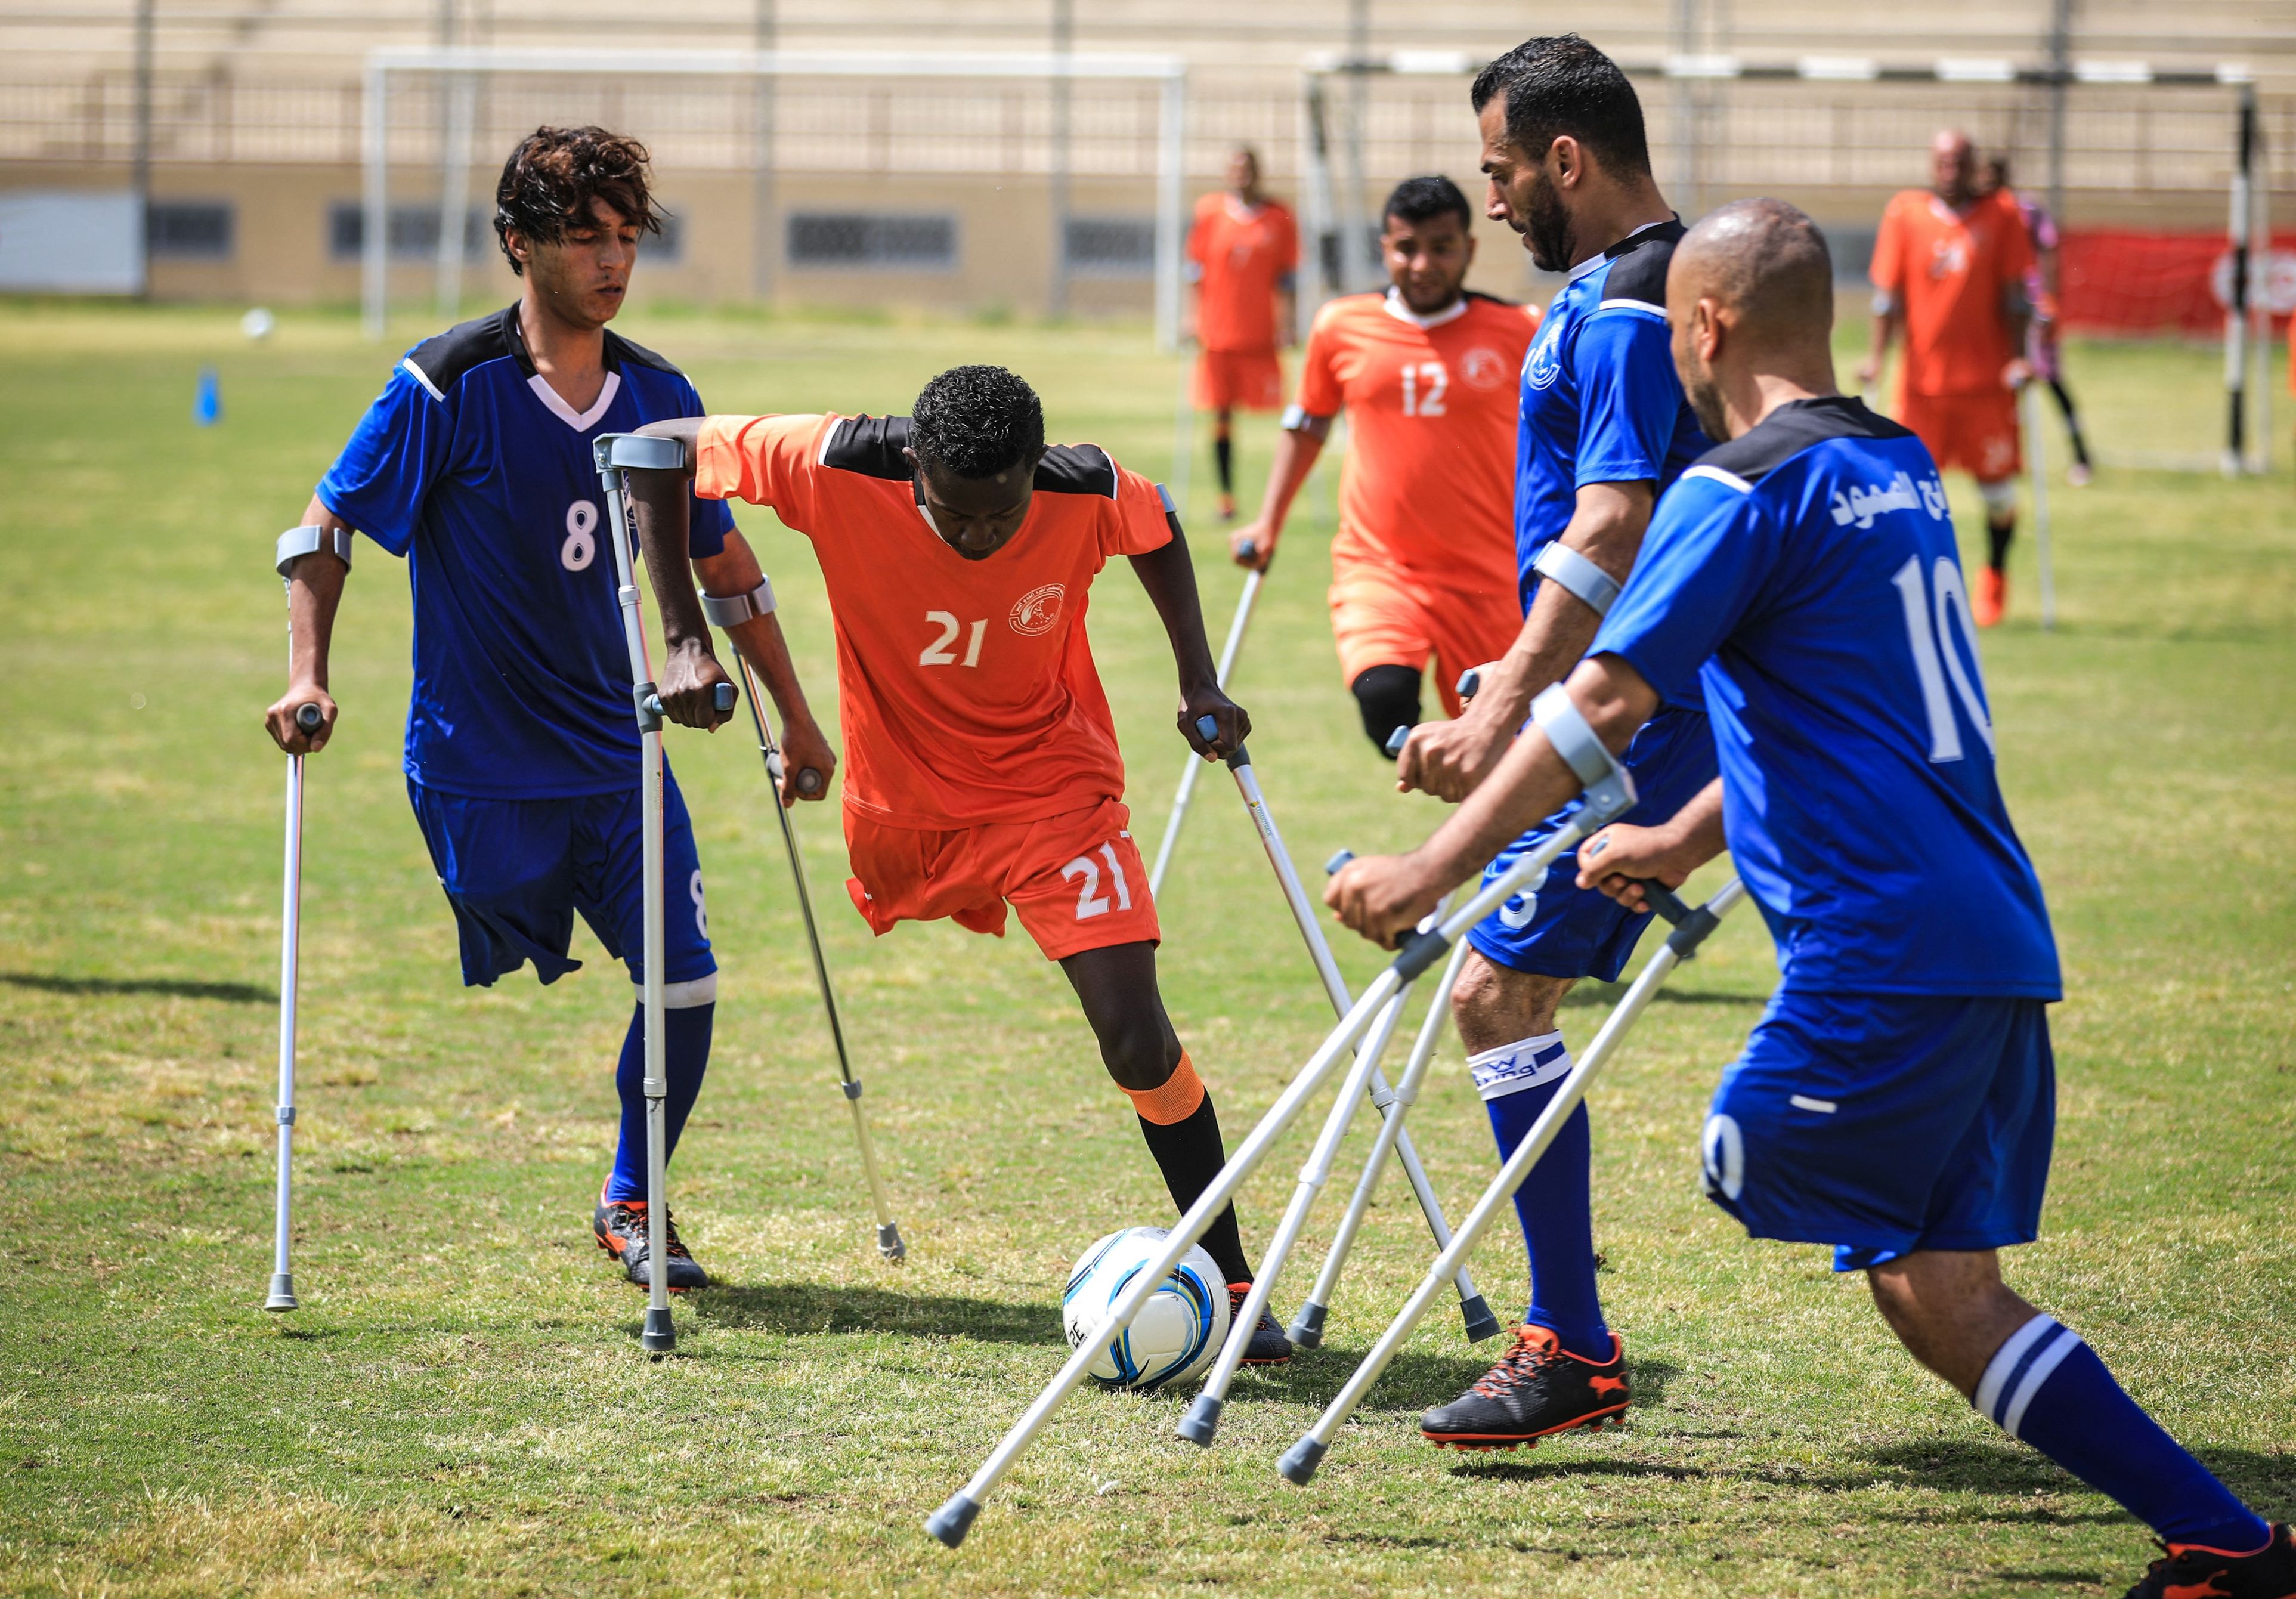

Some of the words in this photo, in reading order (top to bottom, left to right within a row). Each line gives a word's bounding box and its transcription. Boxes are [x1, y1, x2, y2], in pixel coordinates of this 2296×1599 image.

[1401, 361, 1449, 417] 12
[1830, 471, 1923, 530] الصمود
[561, 500, 598, 572] 8
[919, 610, 989, 669] 21
[1890, 553, 1996, 763] 10
[1256, 806, 1272, 836] COSMOTRADE
[689, 869, 708, 941] 8
[1060, 840, 1132, 920] 21
